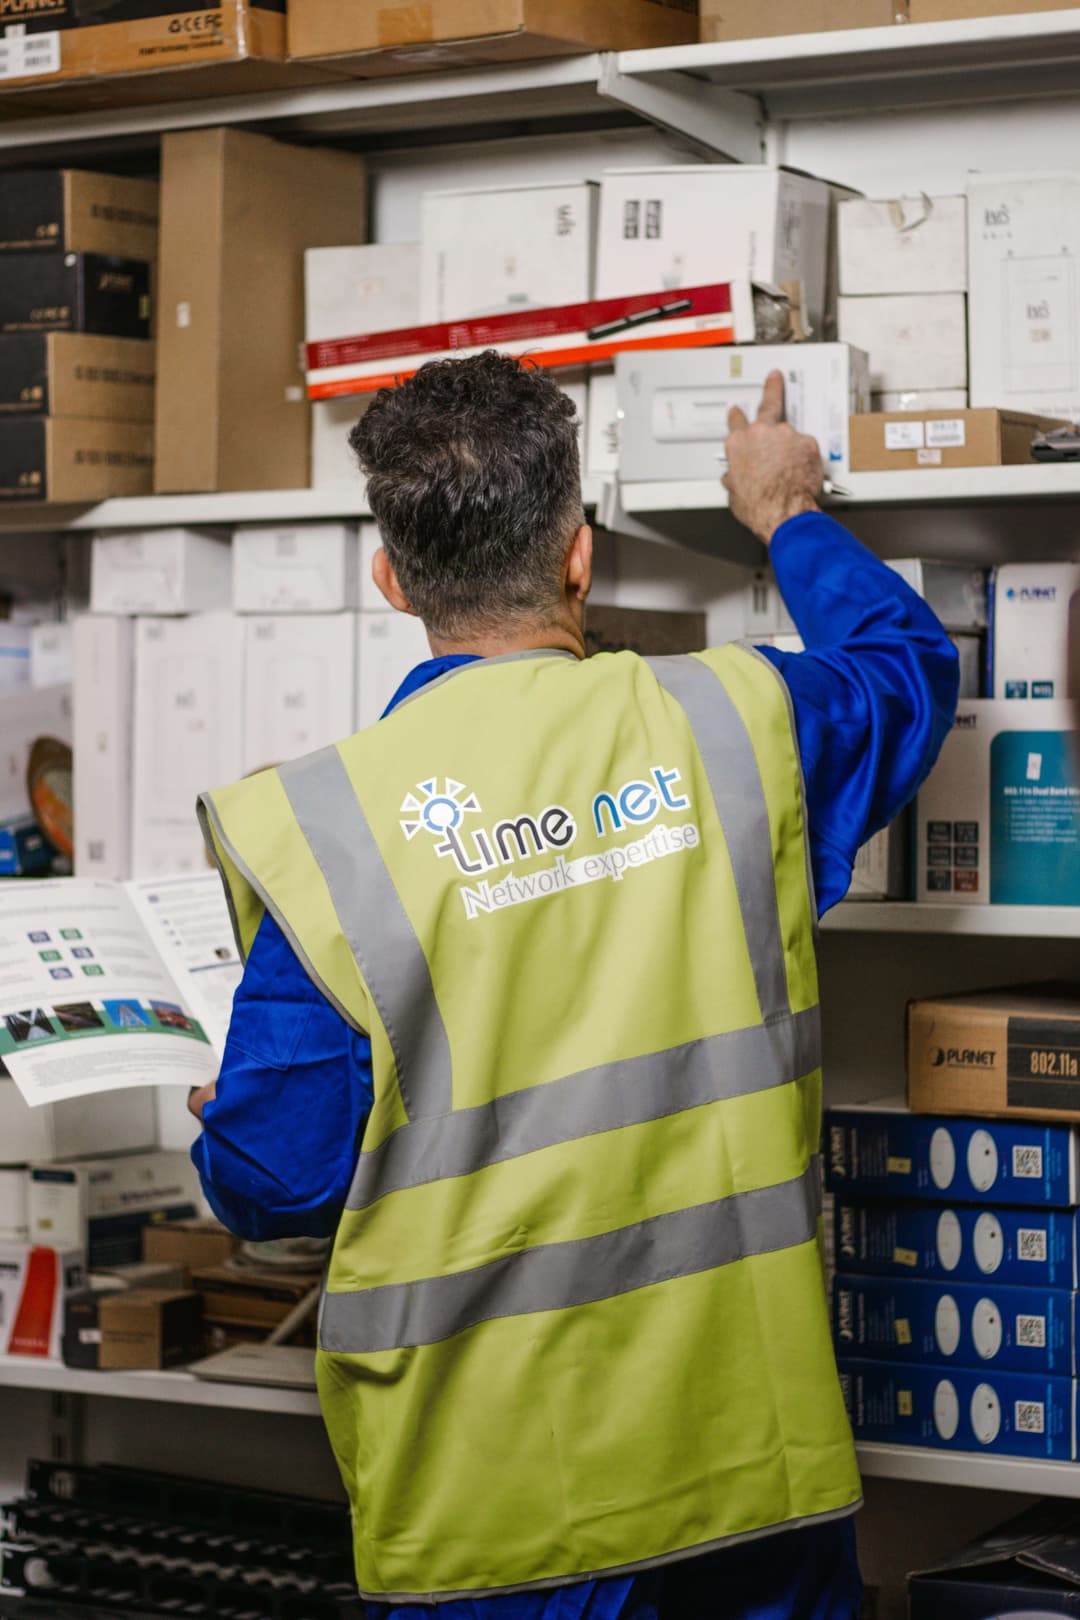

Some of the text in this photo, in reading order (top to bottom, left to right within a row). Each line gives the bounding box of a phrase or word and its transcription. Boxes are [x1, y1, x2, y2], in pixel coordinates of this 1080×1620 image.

[593, 769, 687, 835] net
[463, 827, 699, 917] Network expertise
[946, 1048, 996, 1066] PLANET
[1030, 1051, 1078, 1077] 802.11a
